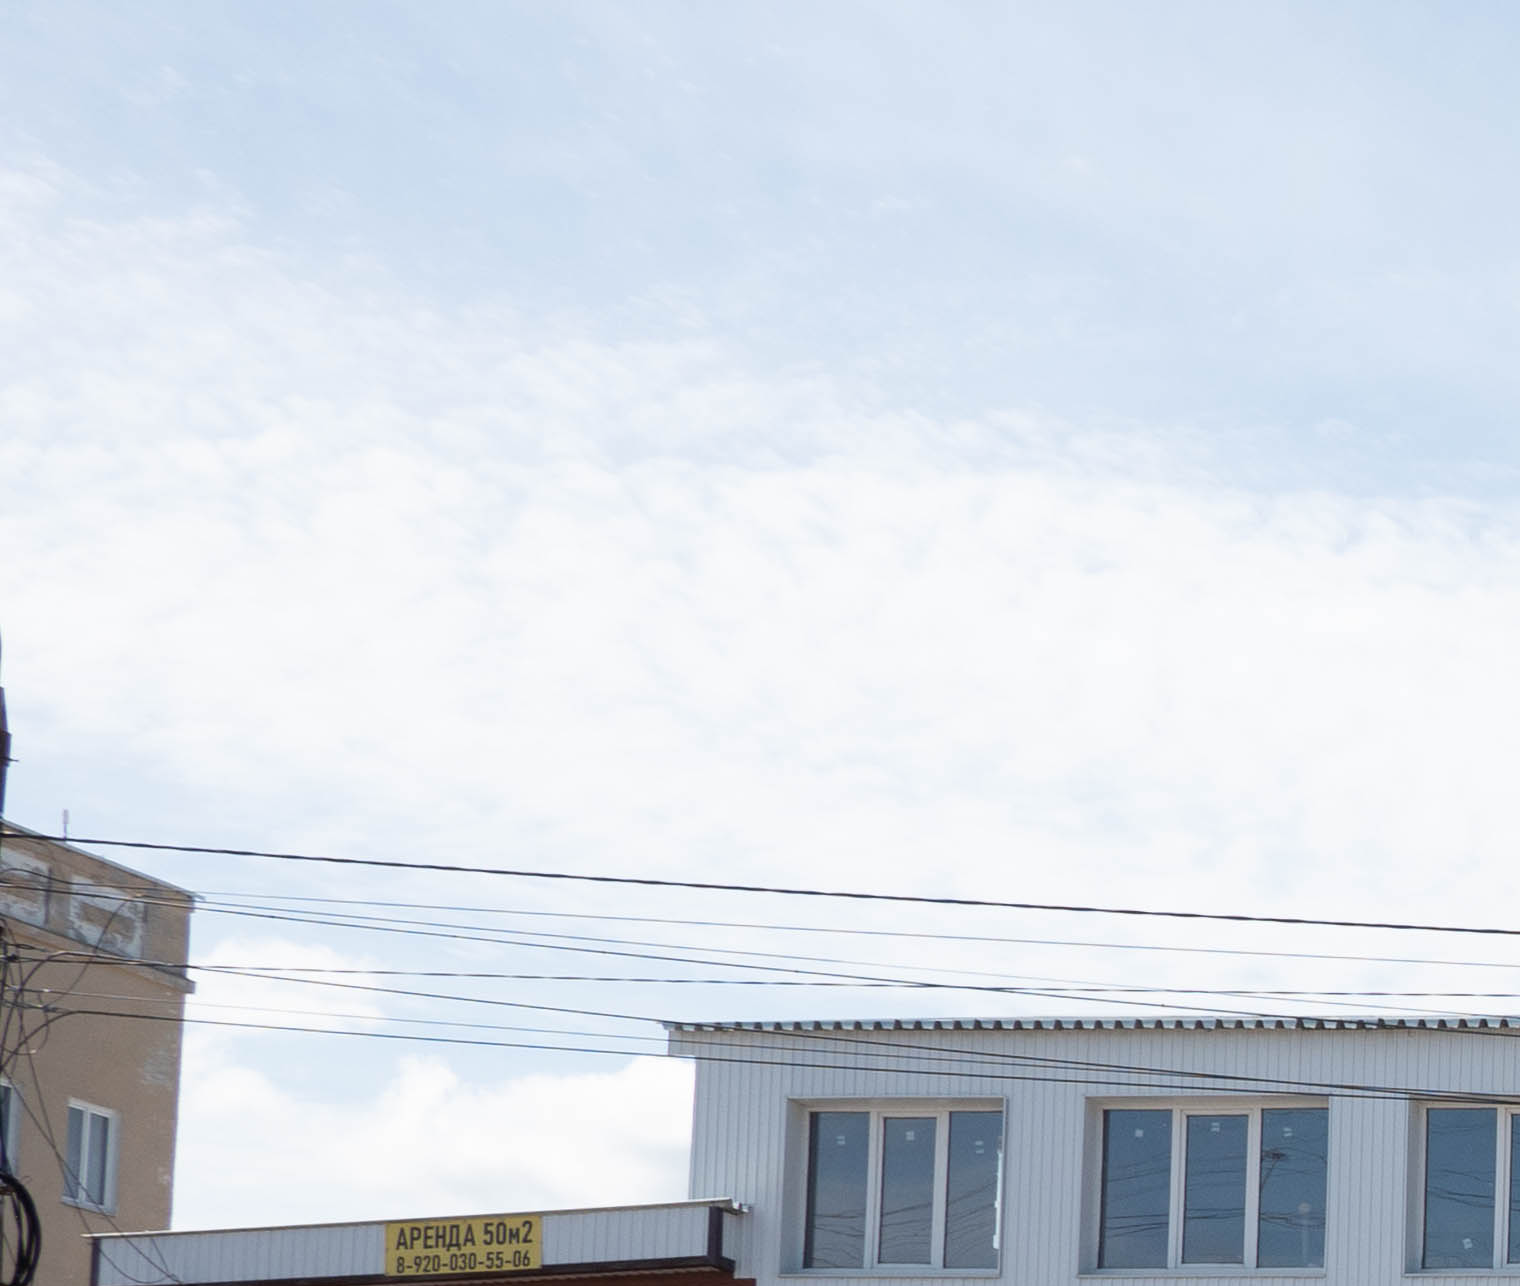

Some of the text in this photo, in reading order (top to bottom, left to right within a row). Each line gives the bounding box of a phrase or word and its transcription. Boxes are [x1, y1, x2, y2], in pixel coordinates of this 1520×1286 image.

[396, 1220, 533, 1251] АРЕНДА 50м2
[396, 1251, 531, 1274] 8-920-030-55-06
